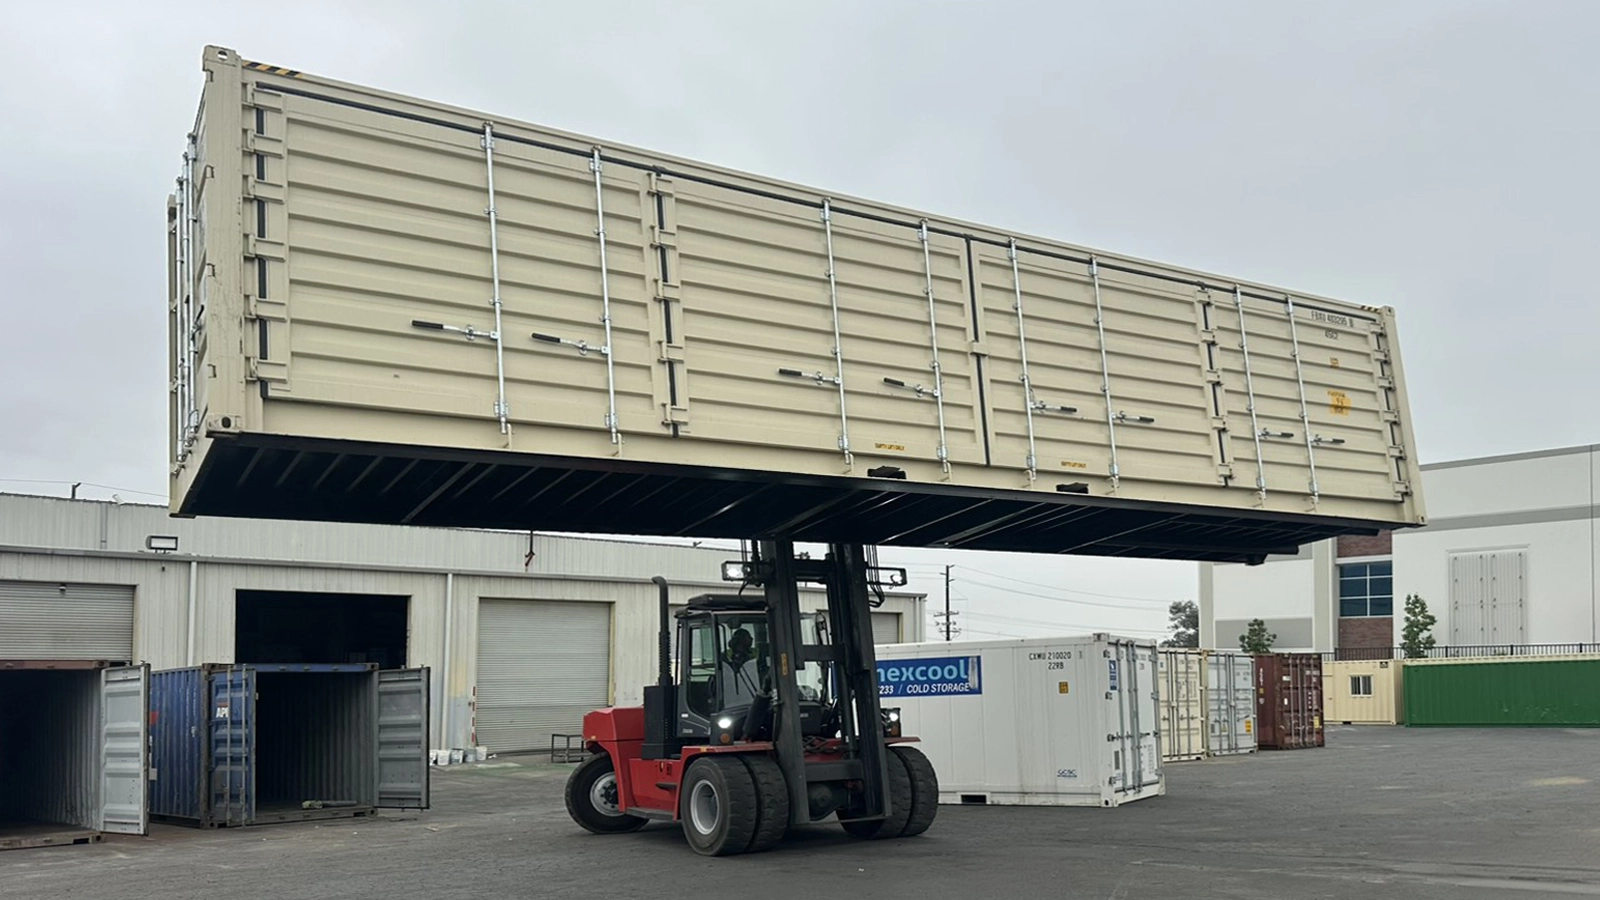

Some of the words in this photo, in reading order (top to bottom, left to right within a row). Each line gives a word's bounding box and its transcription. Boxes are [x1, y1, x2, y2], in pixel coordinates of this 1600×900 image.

[1048, 651, 1071, 660] 210020
[878, 685, 894, 694] 233
[906, 684, 930, 694] COLD
[931, 682, 970, 693] STORAGE
